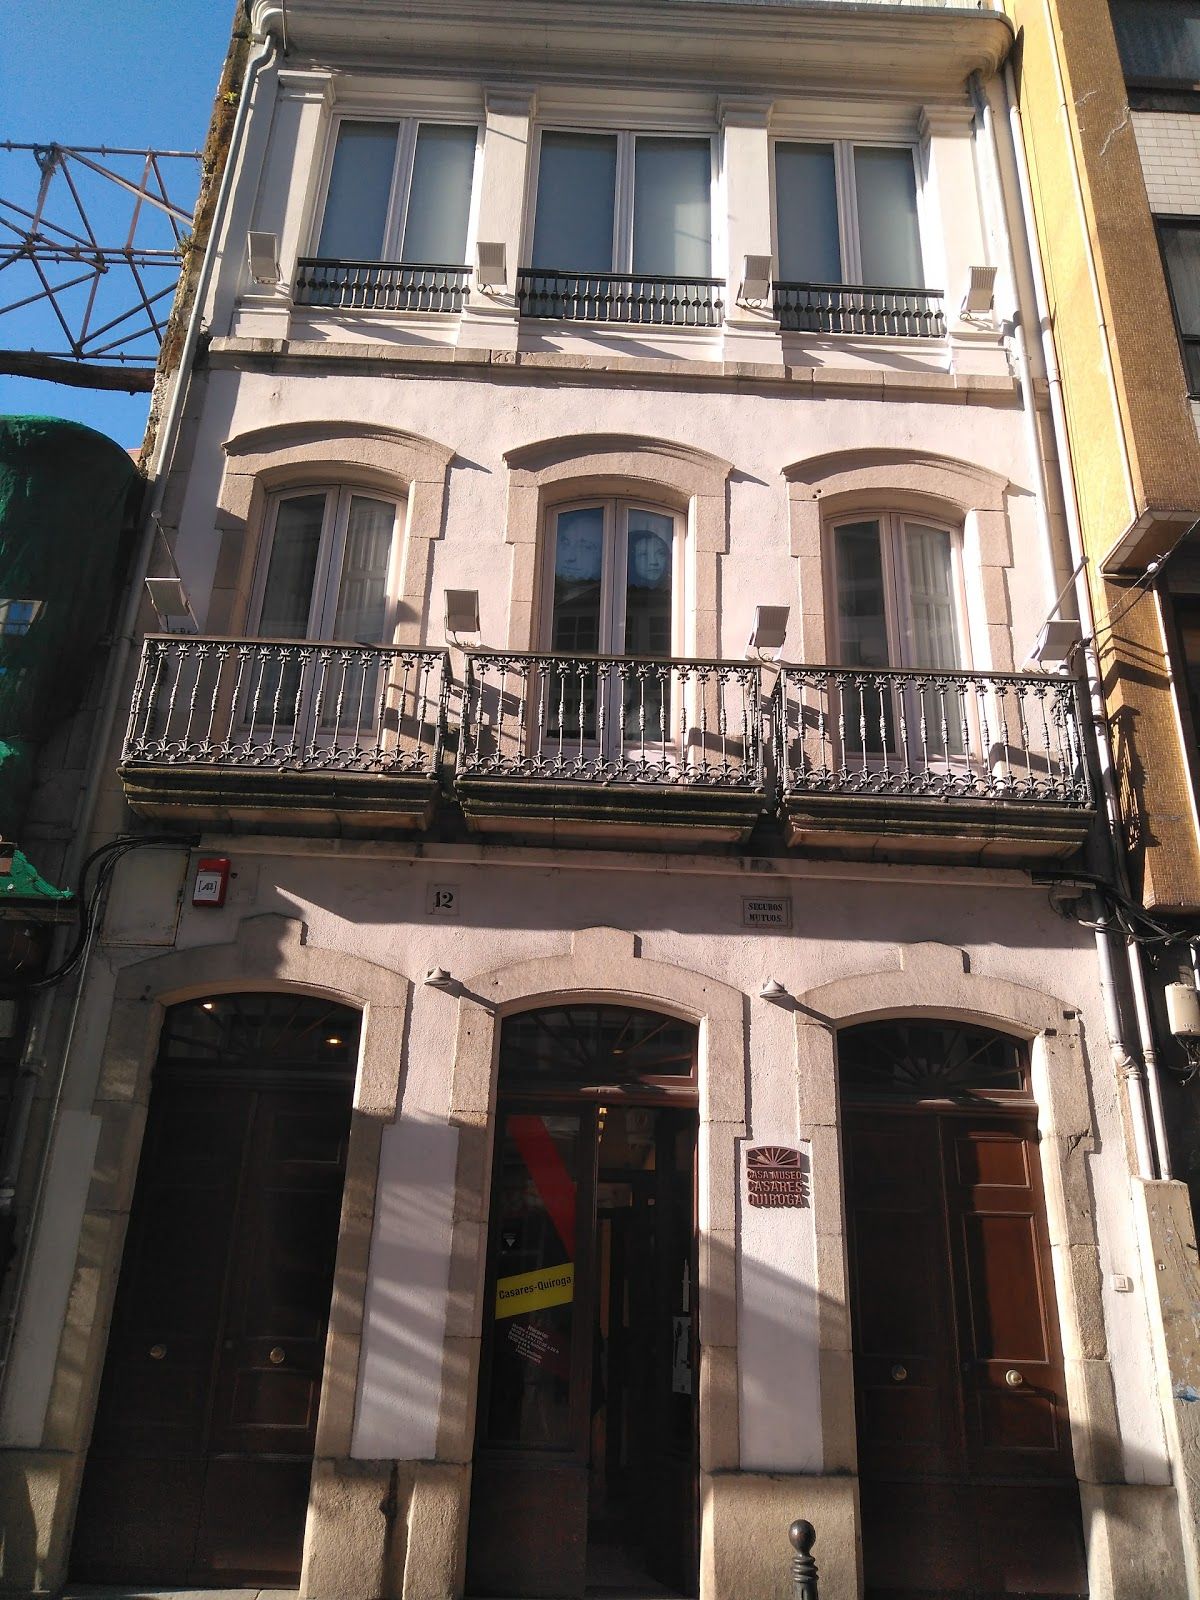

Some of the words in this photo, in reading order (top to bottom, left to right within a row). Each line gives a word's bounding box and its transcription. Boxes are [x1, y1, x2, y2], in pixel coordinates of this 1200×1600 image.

[435, 891, 454, 908] 12
[748, 903, 783, 911] SEGUROS
[747, 1170, 769, 1178] CASA
[769, 1171, 802, 1180] MUSEO
[748, 1181, 803, 1192] CASARES
[748, 1193, 803, 1205] QUIROGA
[499, 1276, 572, 1299] Casares-Quiroga
